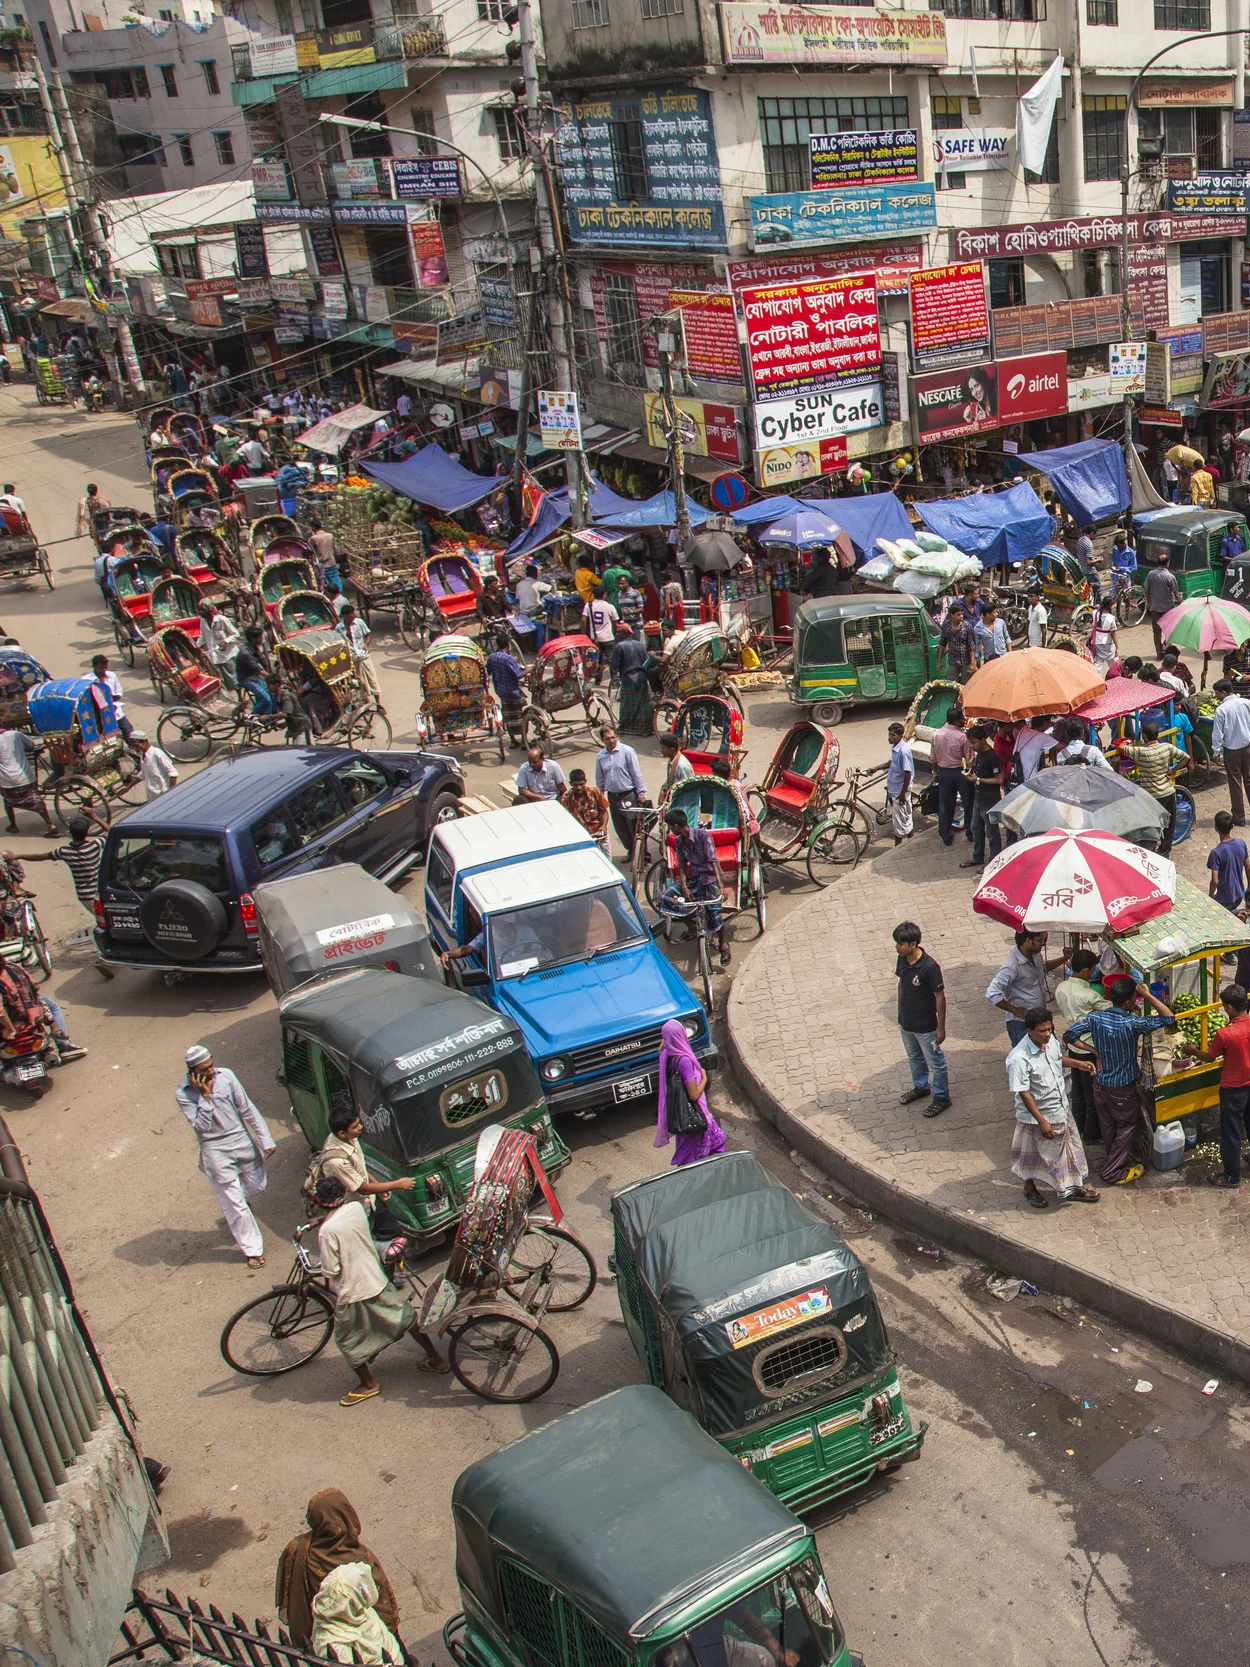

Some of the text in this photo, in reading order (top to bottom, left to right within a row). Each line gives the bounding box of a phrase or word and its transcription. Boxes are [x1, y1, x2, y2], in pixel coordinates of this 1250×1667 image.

[758, 7, 780, 35] শান্তি
[897, 13, 931, 40] সোসাইটি
[803, 36, 830, 50] ইসলামী
[1146, 83, 1229, 99] নোটারী পাবলিক
[660, 89, 699, 114] চলিতেছে
[811, 130, 917, 152] D.M.C পলিটেকনিক ভর্তি কোচিং
[945, 137, 1008, 154] SAFE WAY
[432, 160, 458, 171] CEBIS
[945, 151, 1009, 162] Your Reliable Transport
[1171, 174, 1211, 190] অনুবাদ
[1211, 175, 1221, 188] ও
[754, 206, 793, 223] ঢাকা
[798, 197, 883, 218] টেকনিক্যাল
[886, 193, 933, 209] কলেজ
[1172, 195, 1247, 208] ৩য় তলায়
[577, 200, 713, 231] ঢাকা টেকনিক্যাল কলেজ
[957, 229, 1000, 256] বিকাশ
[1142, 218, 1172, 239] কেন্দ্র
[731, 253, 920, 281] যোগাযোগ অনুবাদ কেন্দ্র
[911, 264, 981, 283] যোগাযোগ চেম্বার
[754, 278, 865, 299] সরকার অনুমোদিত
[746, 287, 876, 320] যোগাযোগ অনুবাদ কেন্দ্র
[809, 312, 820, 323] ও
[750, 313, 877, 346] নোটারী পাবলিক
[752, 350, 773, 363] এখানে
[772, 366, 785, 377] সহ
[811, 357, 827, 370] ভাষা
[828, 355, 852, 368] অনুবাদ
[853, 351, 865, 363] করা
[867, 349, 877, 360] হয়
[1028, 372, 1060, 394] airtel
[795, 393, 833, 412] SUN
[918, 384, 962, 408] NESCAFÉ
[761, 399, 880, 441] Cyber Cafe
[816, 427, 830, 436] 2nd
[830, 424, 848, 433] Floor
[921, 429, 942, 443] তায়েফ
[766, 461, 792, 474] NIDO
[593, 611, 604, 625] 9
[1041, 887, 1075, 910] রবি
[157, 930, 193, 939] MITSUBISHI
[158, 923, 189, 932] PAJERO
[323, 931, 387, 960] প্রাইভেট
[604, 1041, 642, 1057] DAIHATSU
[753, 1302, 800, 1330] Today
